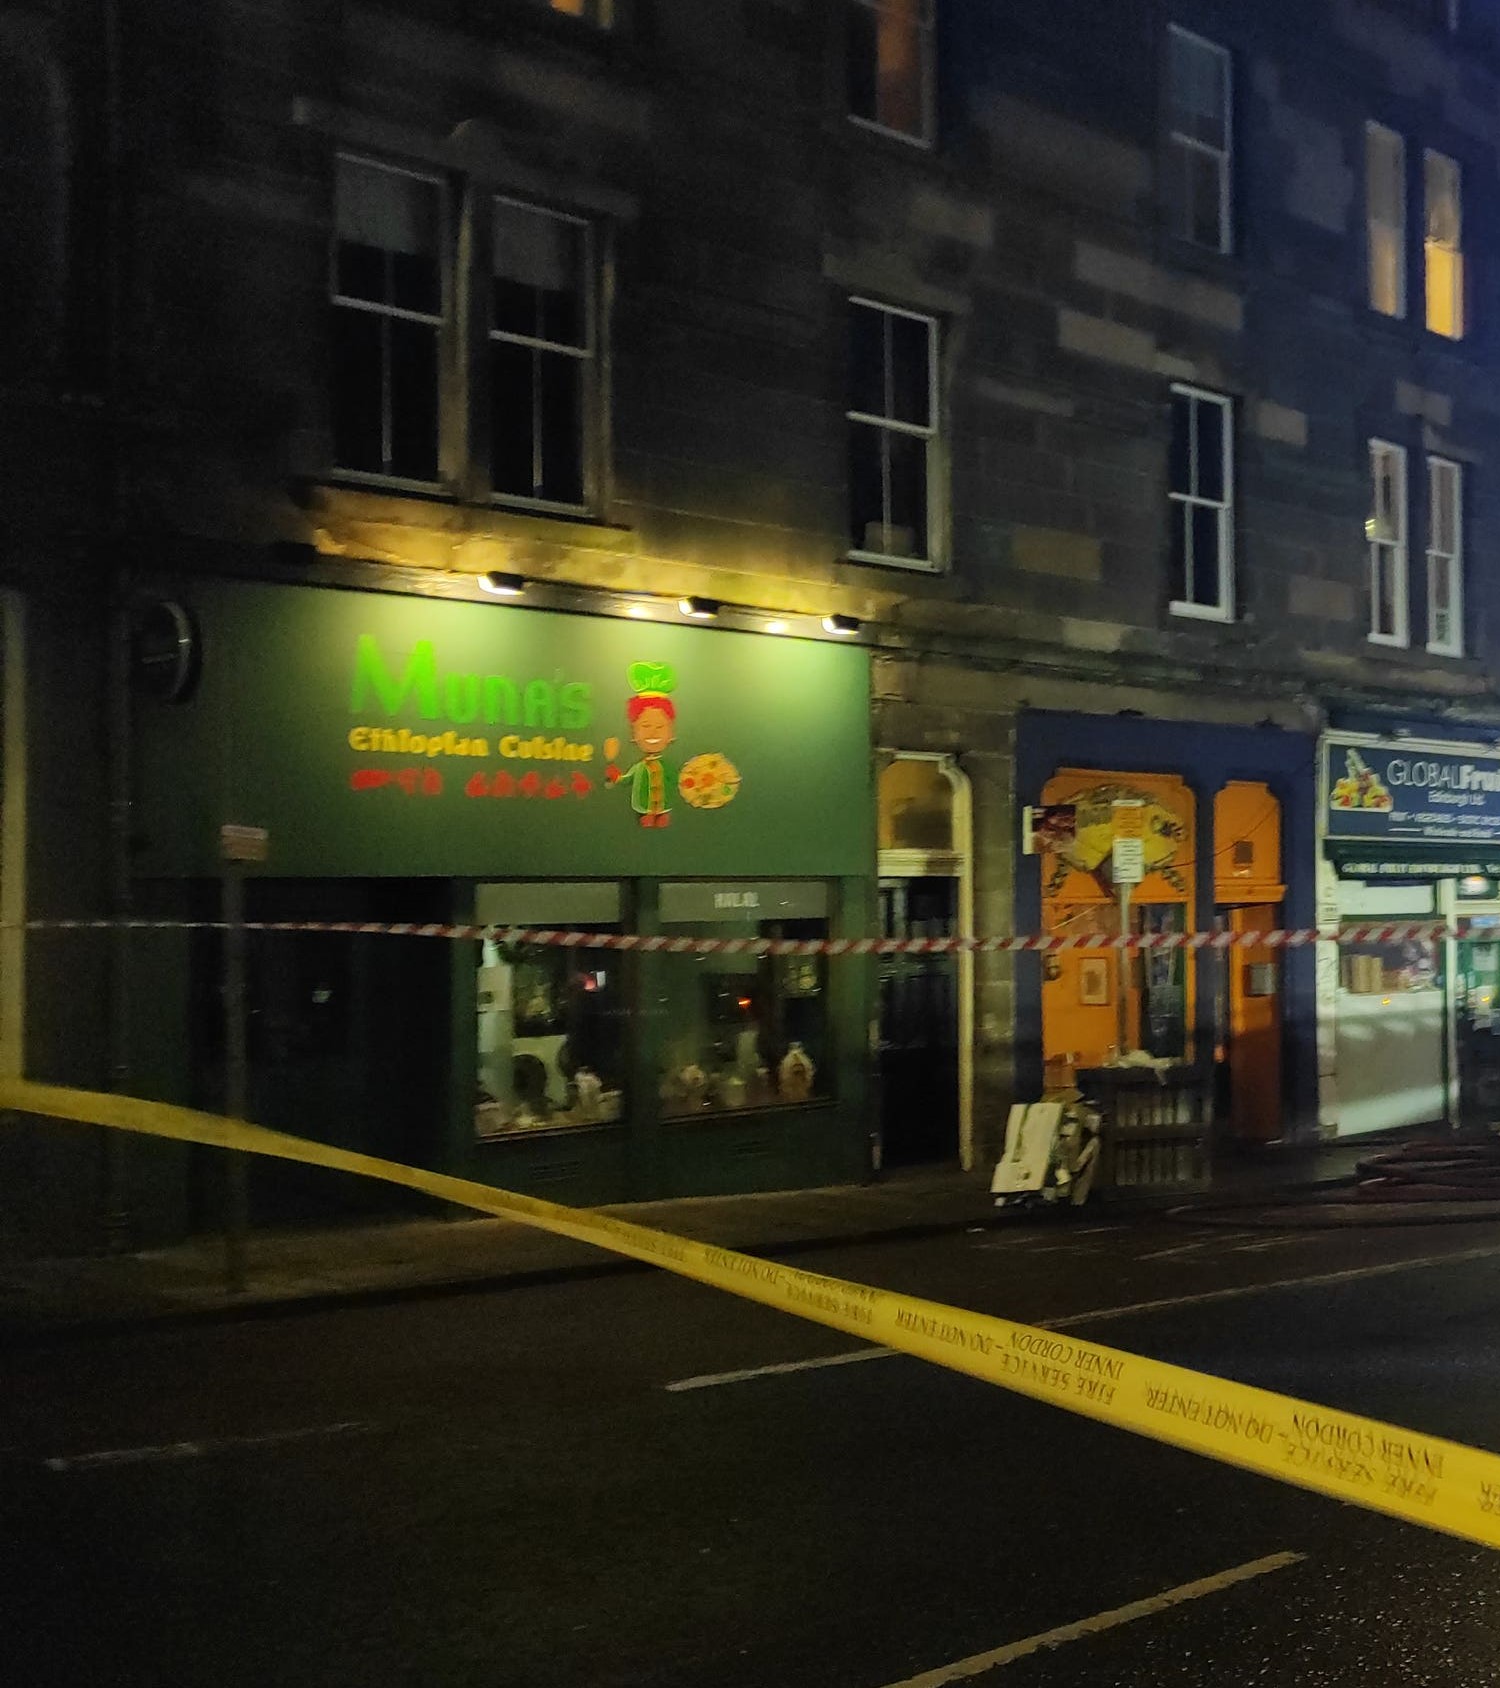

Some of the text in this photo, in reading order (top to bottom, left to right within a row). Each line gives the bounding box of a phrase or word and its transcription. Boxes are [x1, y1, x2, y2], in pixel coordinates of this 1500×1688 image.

[348, 727, 594, 762] Ethiopian Cuisine
[1011, 1331, 1125, 1381] INNER CORDON
[1002, 1353, 1117, 1406] FIRE SERVICE
[1144, 1384, 1200, 1421] ENTER
[1281, 1442, 1377, 1485] SERVICE
[1292, 1412, 1445, 1480] INNER CORDON
